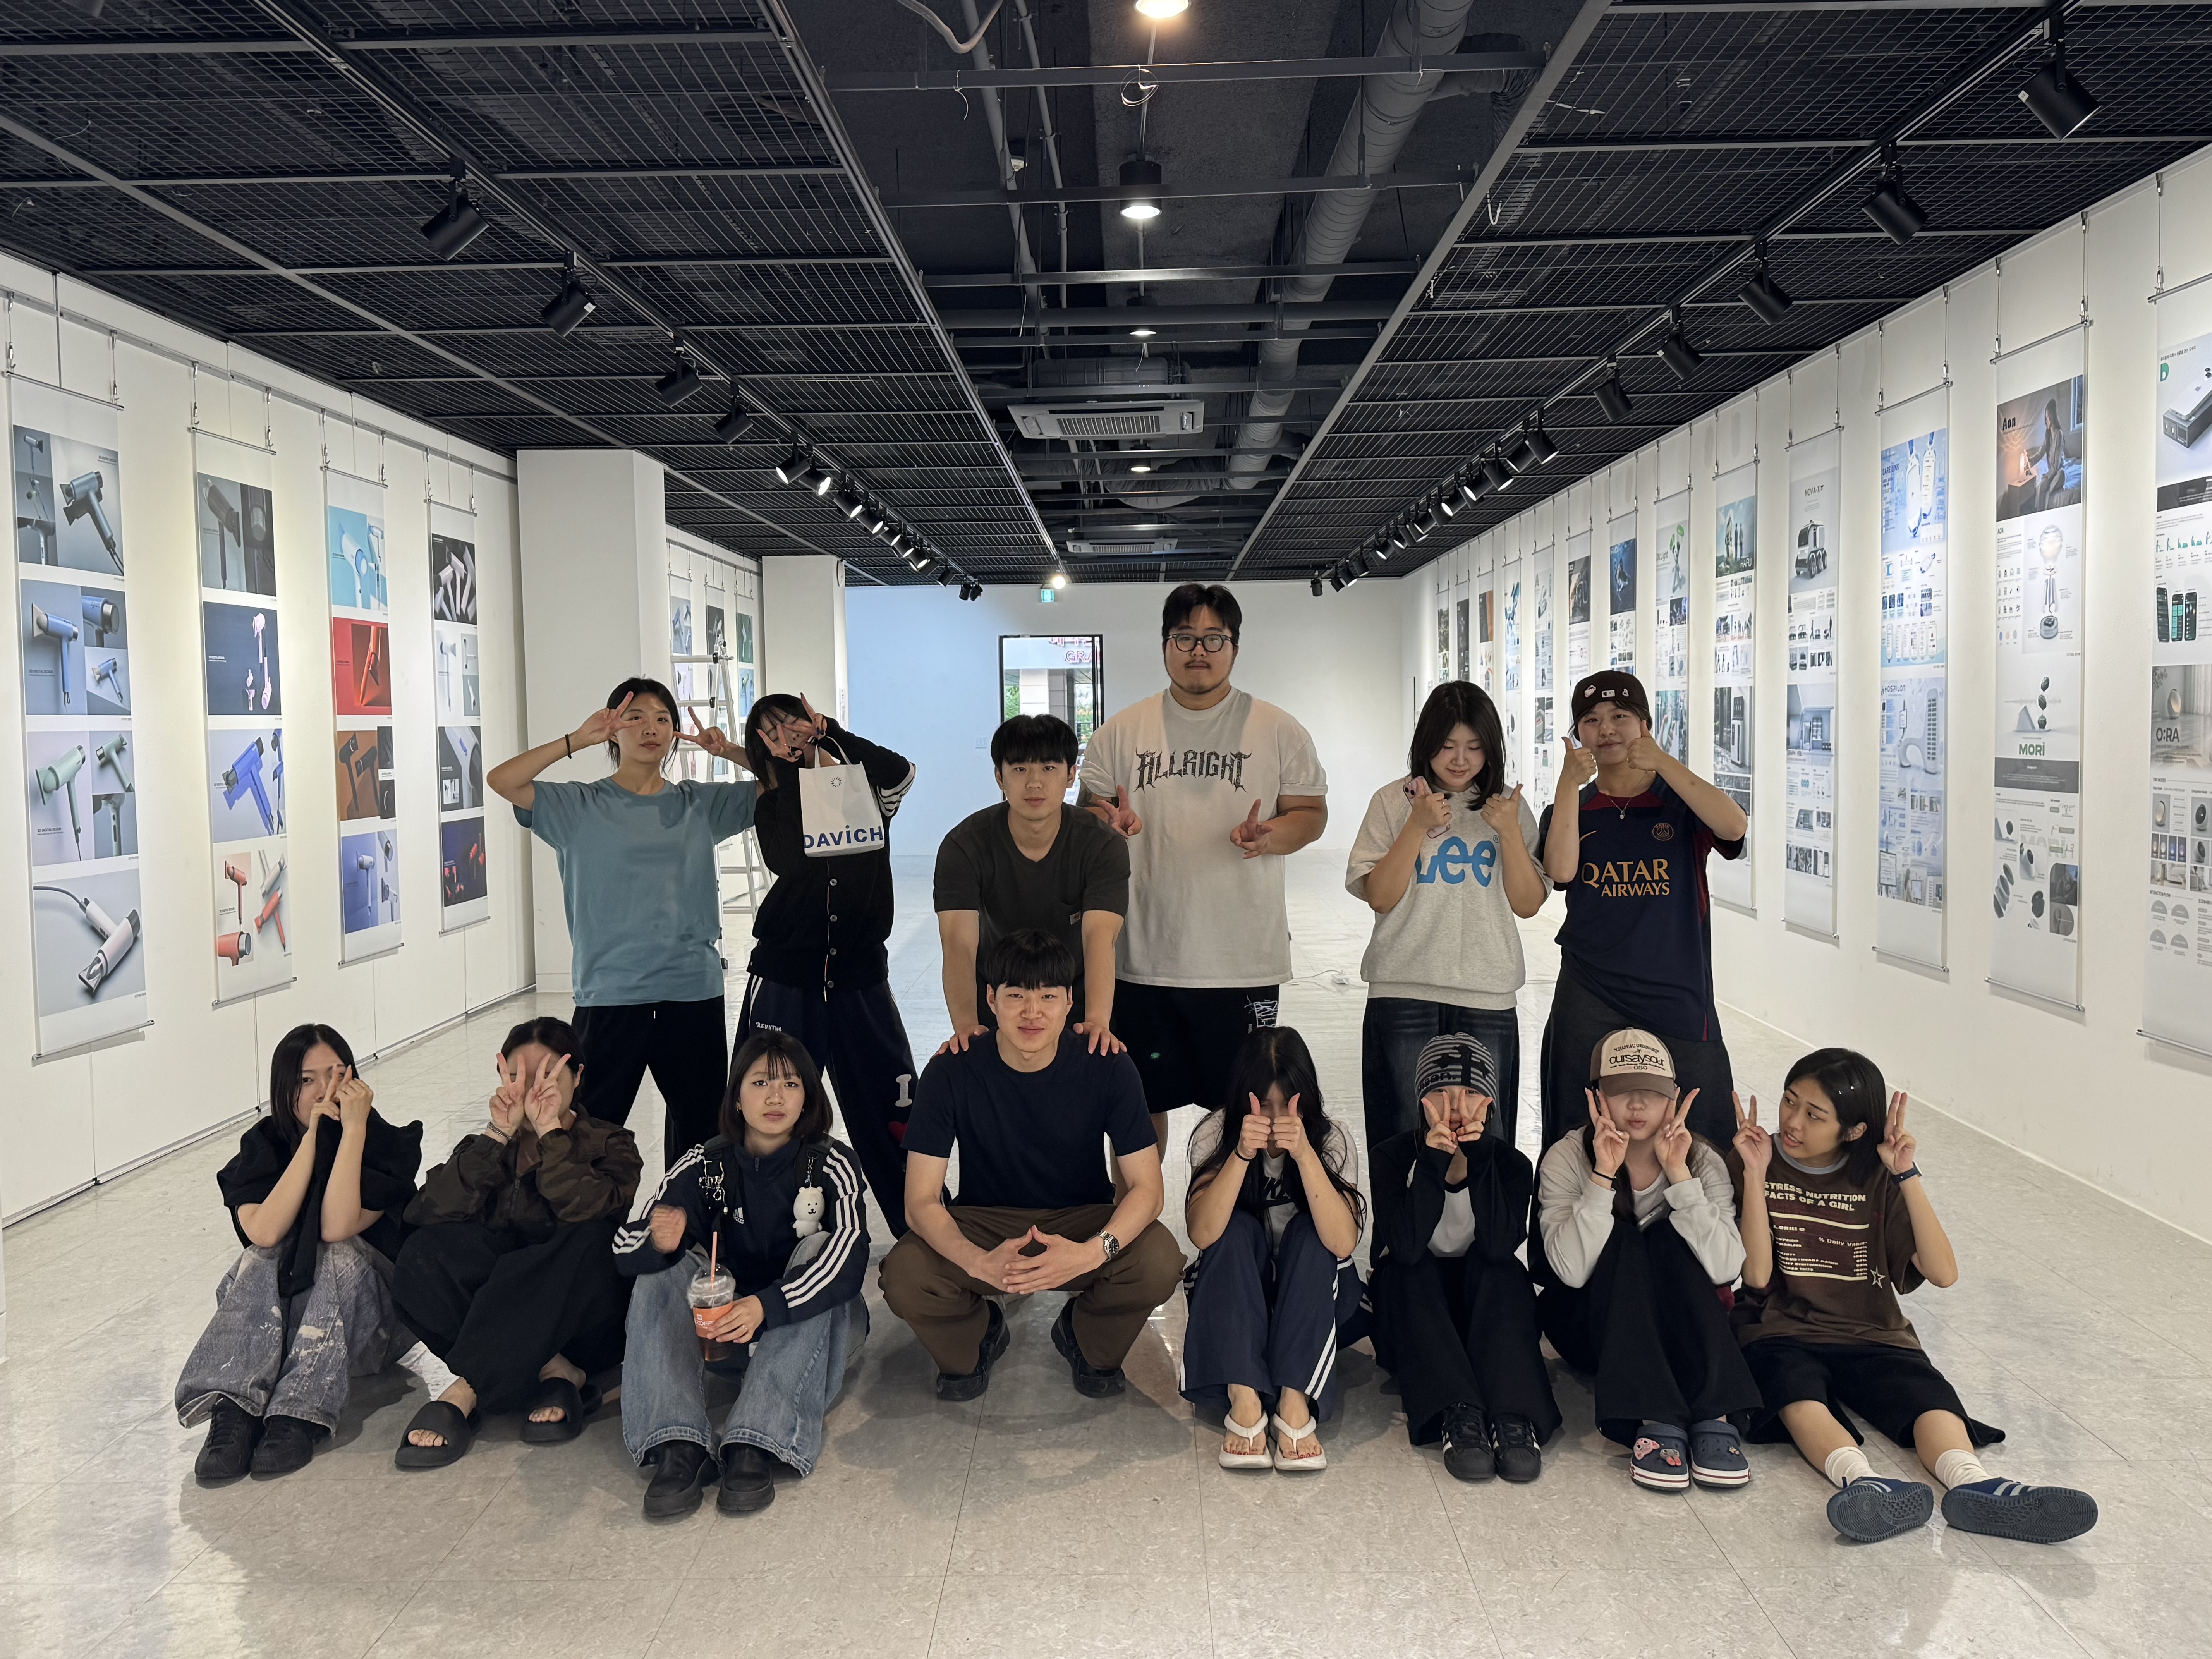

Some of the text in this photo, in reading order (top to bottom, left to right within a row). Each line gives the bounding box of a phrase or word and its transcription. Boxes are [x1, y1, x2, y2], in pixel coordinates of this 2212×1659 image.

[2002, 417, 2016, 431] Aon
[1581, 859, 1670, 888] QATAR
[1601, 882, 1670, 897] AIRWAYS
[1764, 1190, 1796, 1200] FACTS
[1799, 1196, 1814, 1204] OF
[1829, 1202, 1855, 1211] GIRL
[1765, 1181, 1866, 1202] STRESS NUTRITION
